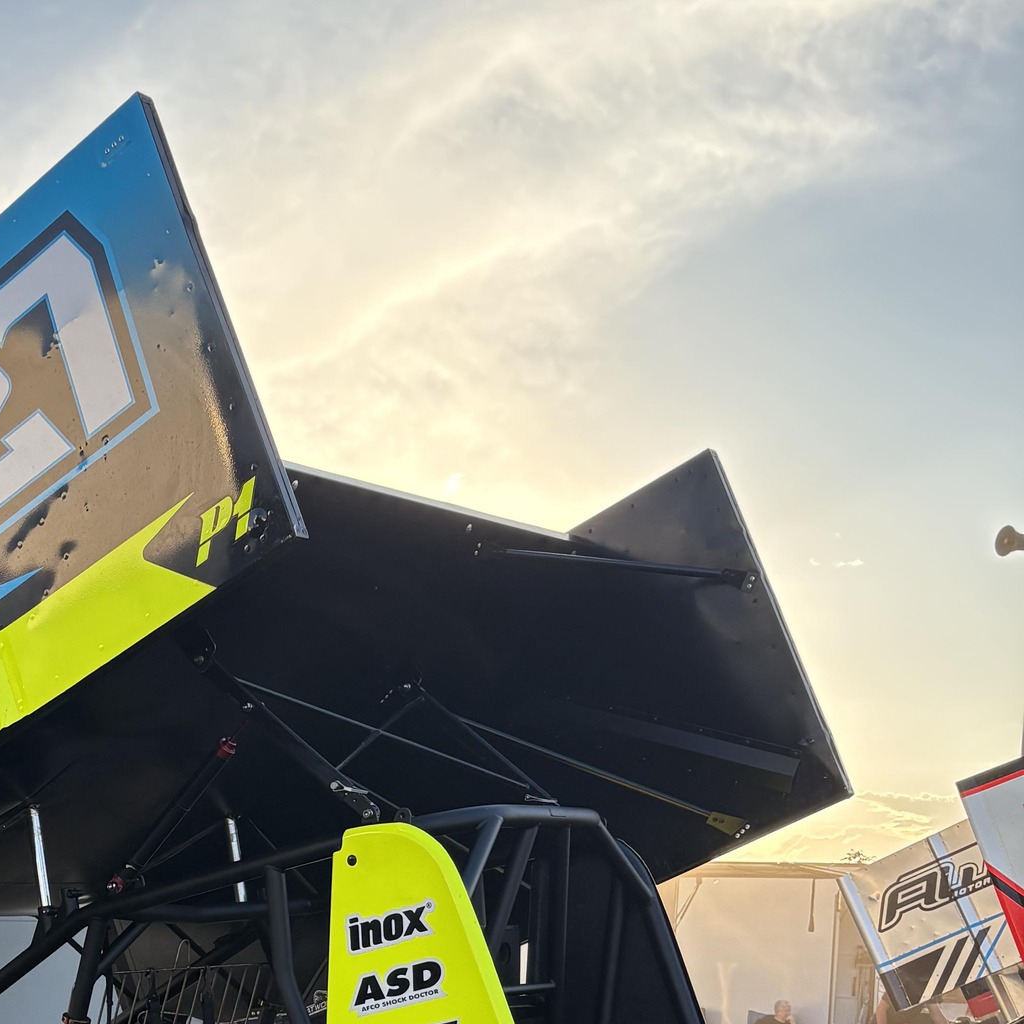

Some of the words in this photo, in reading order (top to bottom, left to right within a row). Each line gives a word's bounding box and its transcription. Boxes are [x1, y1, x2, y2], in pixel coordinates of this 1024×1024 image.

[195, 476, 256, 567] P1
[354, 961, 442, 1006] ASD
[361, 1003, 380, 1013] AFCO
[382, 997, 408, 1008] SHOCK
[409, 989, 439, 1001] DOCTOR
